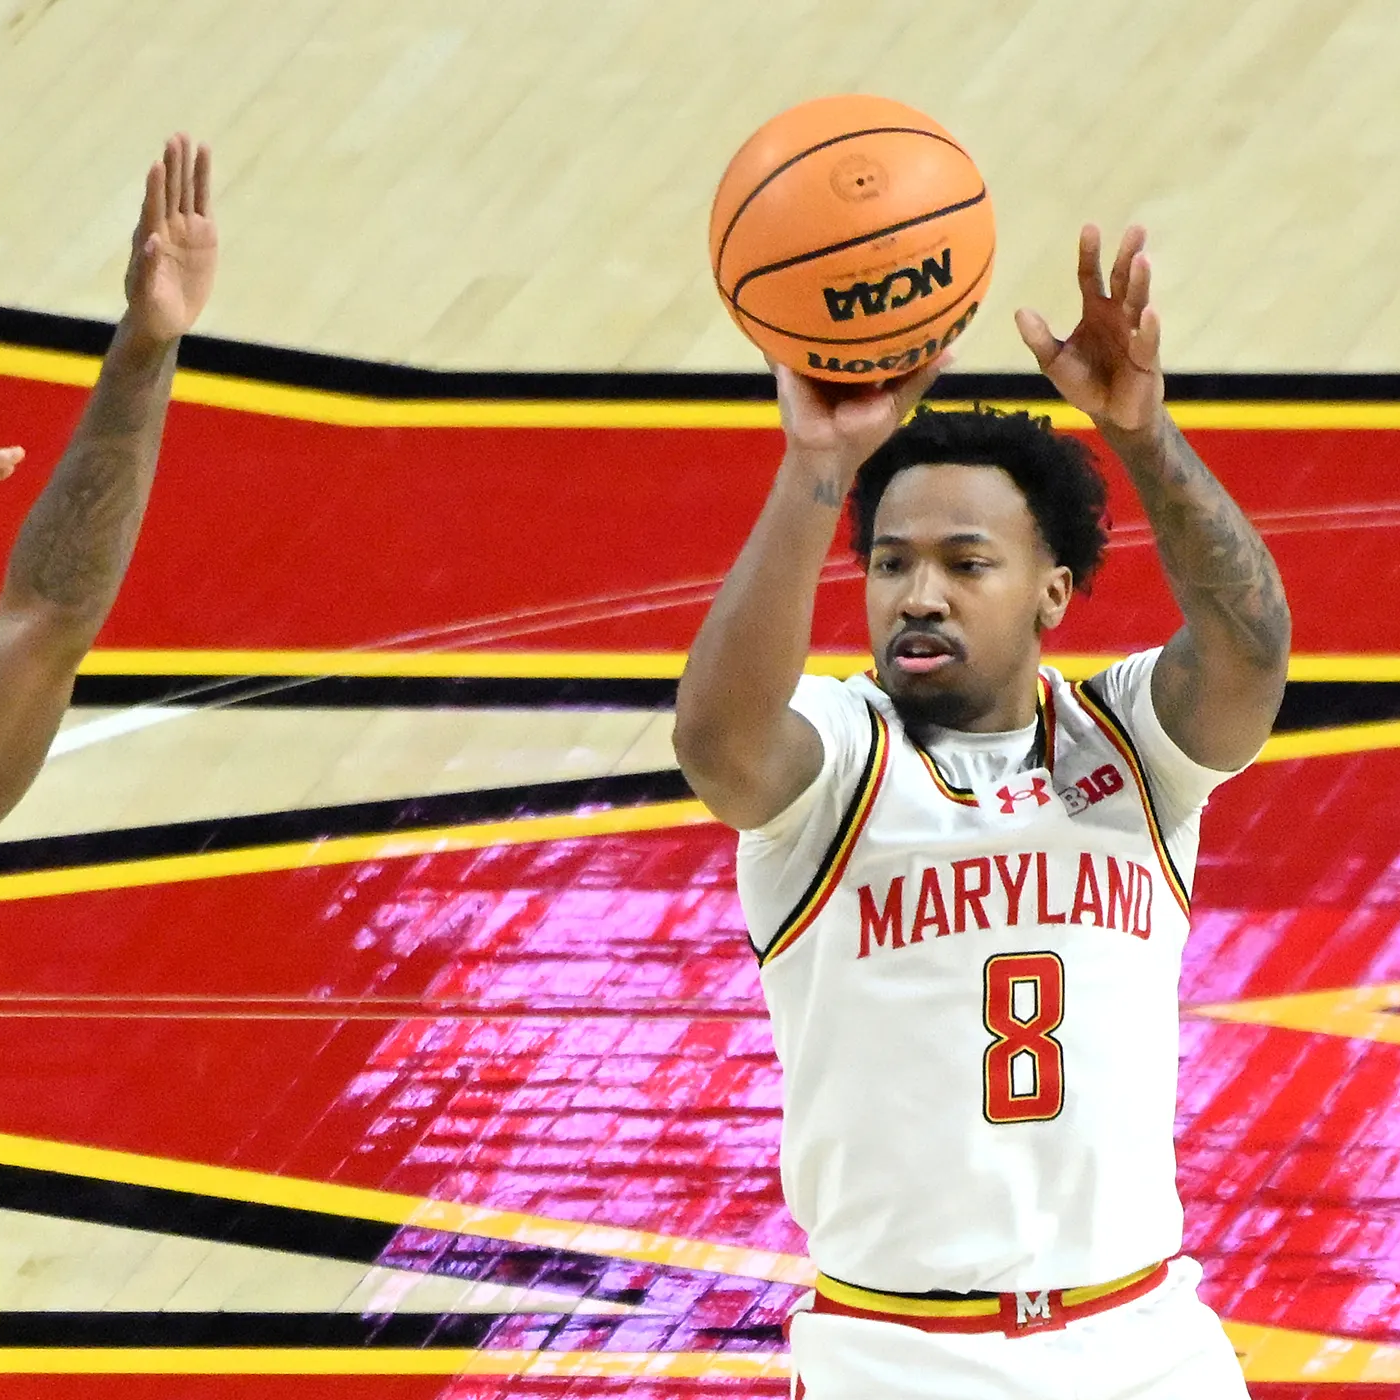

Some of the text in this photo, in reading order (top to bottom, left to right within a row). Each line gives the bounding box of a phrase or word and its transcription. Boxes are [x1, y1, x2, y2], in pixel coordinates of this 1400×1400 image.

[822, 248, 953, 321] NCAA
[857, 852, 1153, 959] MARYLAND
[983, 951, 1064, 1124] 8
[1015, 1290, 1052, 1324] M
